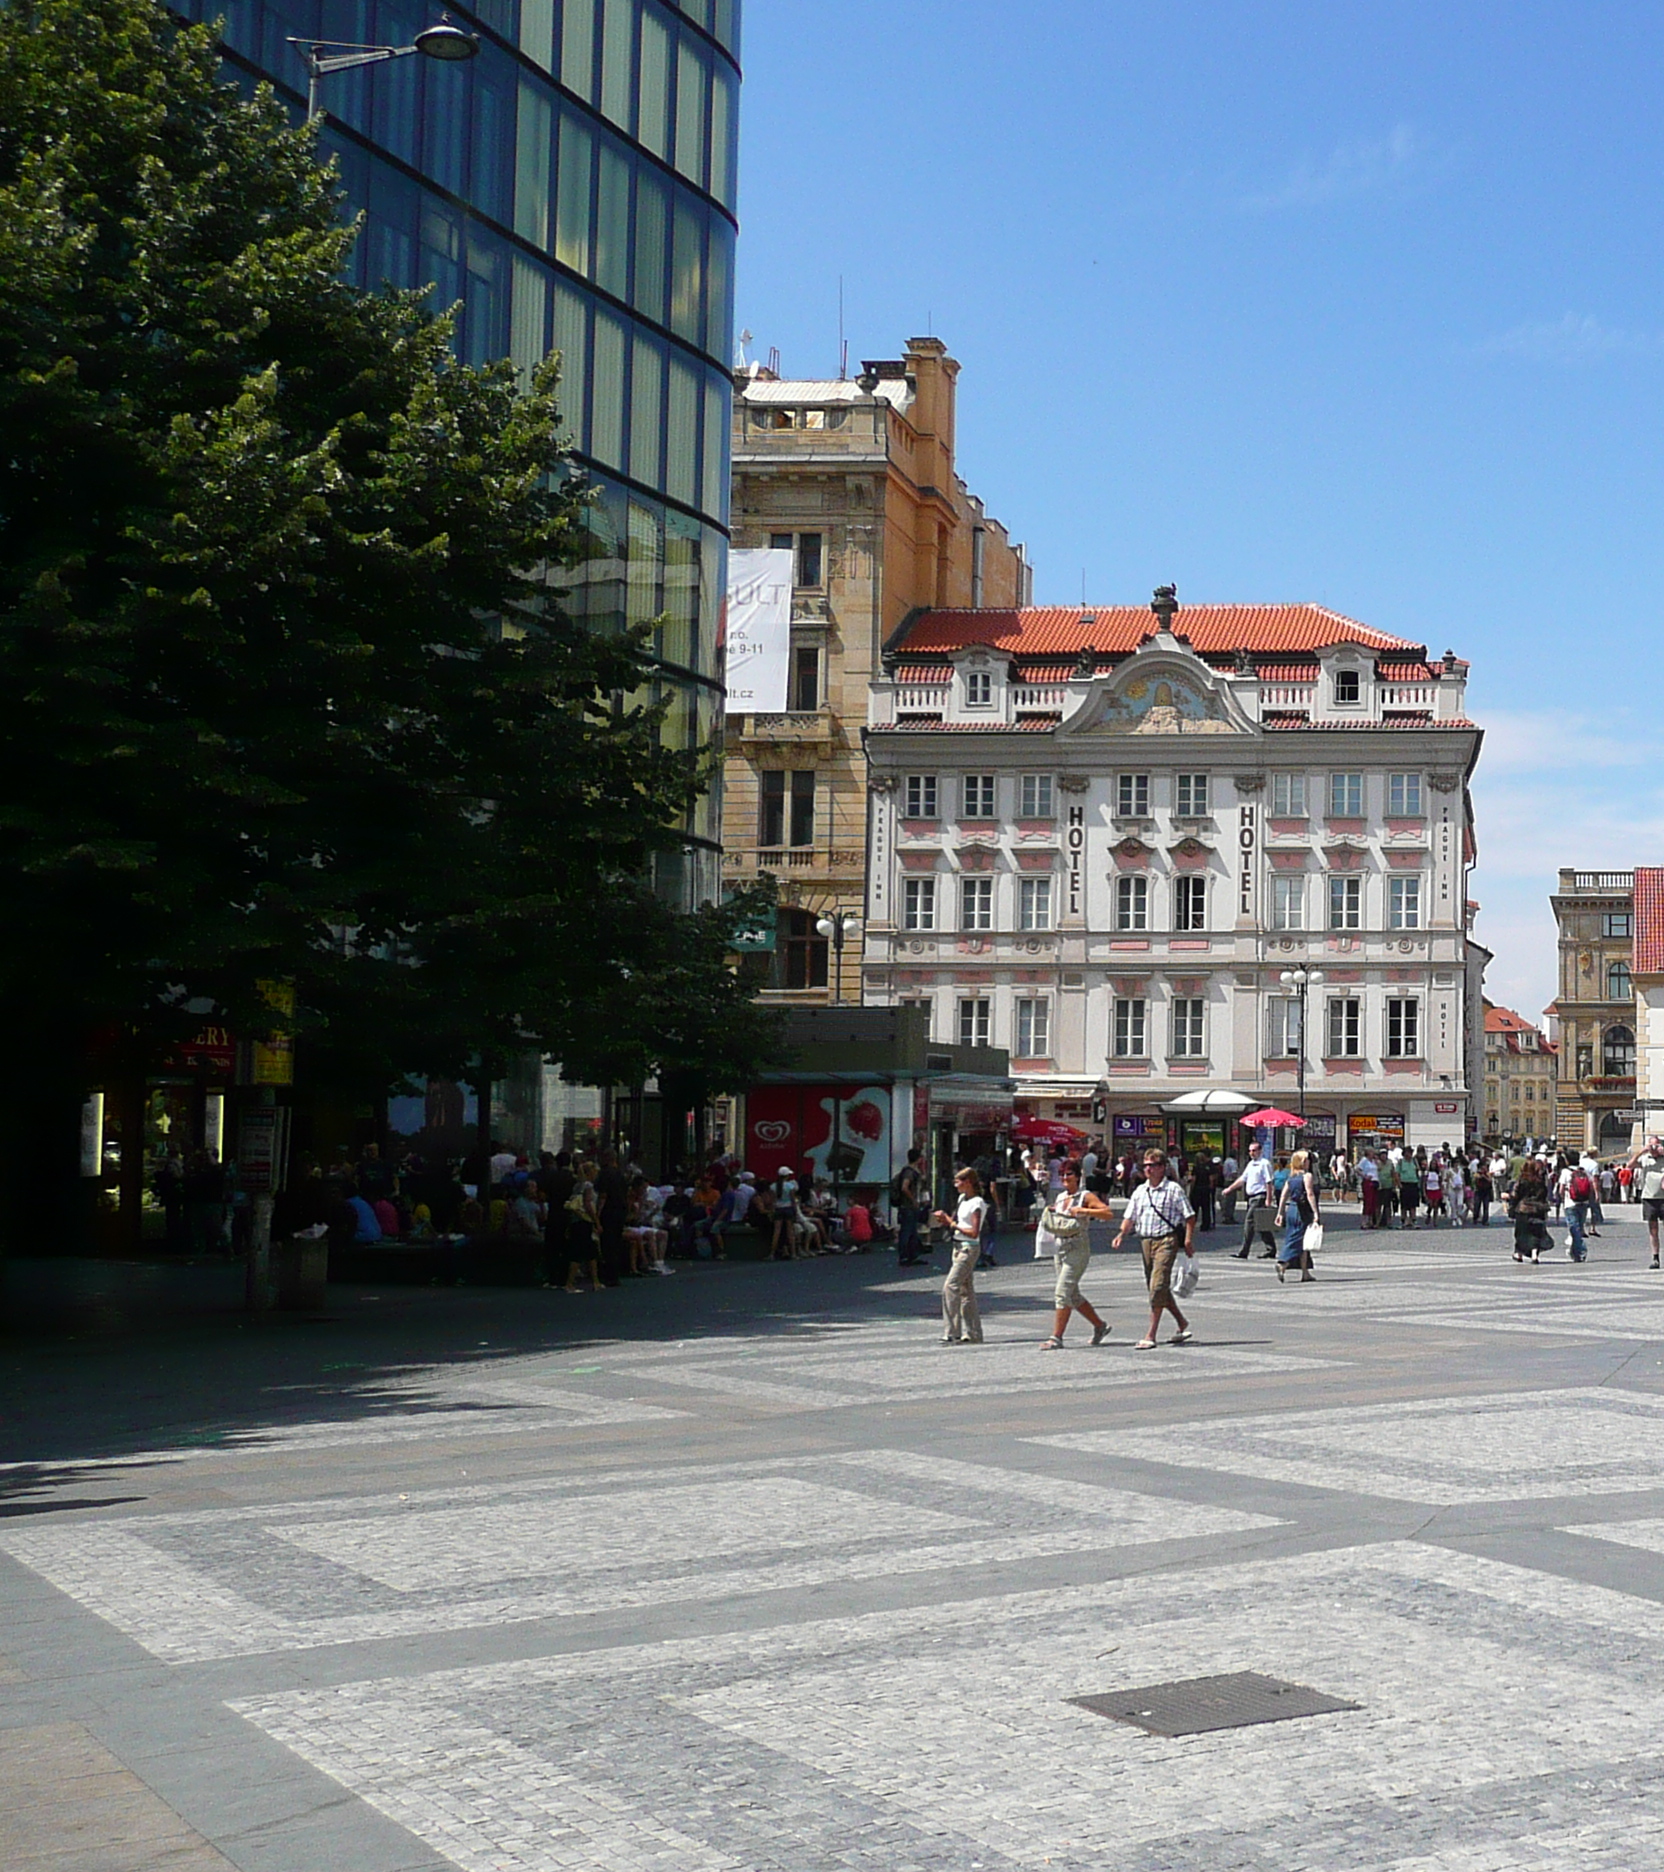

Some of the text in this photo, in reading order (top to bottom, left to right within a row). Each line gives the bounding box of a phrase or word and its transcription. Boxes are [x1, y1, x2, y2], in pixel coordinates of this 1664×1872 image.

[739, 644, 763, 654] 9-11
[1069, 806, 1083, 914] HOTEL
[1239, 806, 1254, 914] HOTEL
[1350, 1117, 1376, 1128] Kodak
